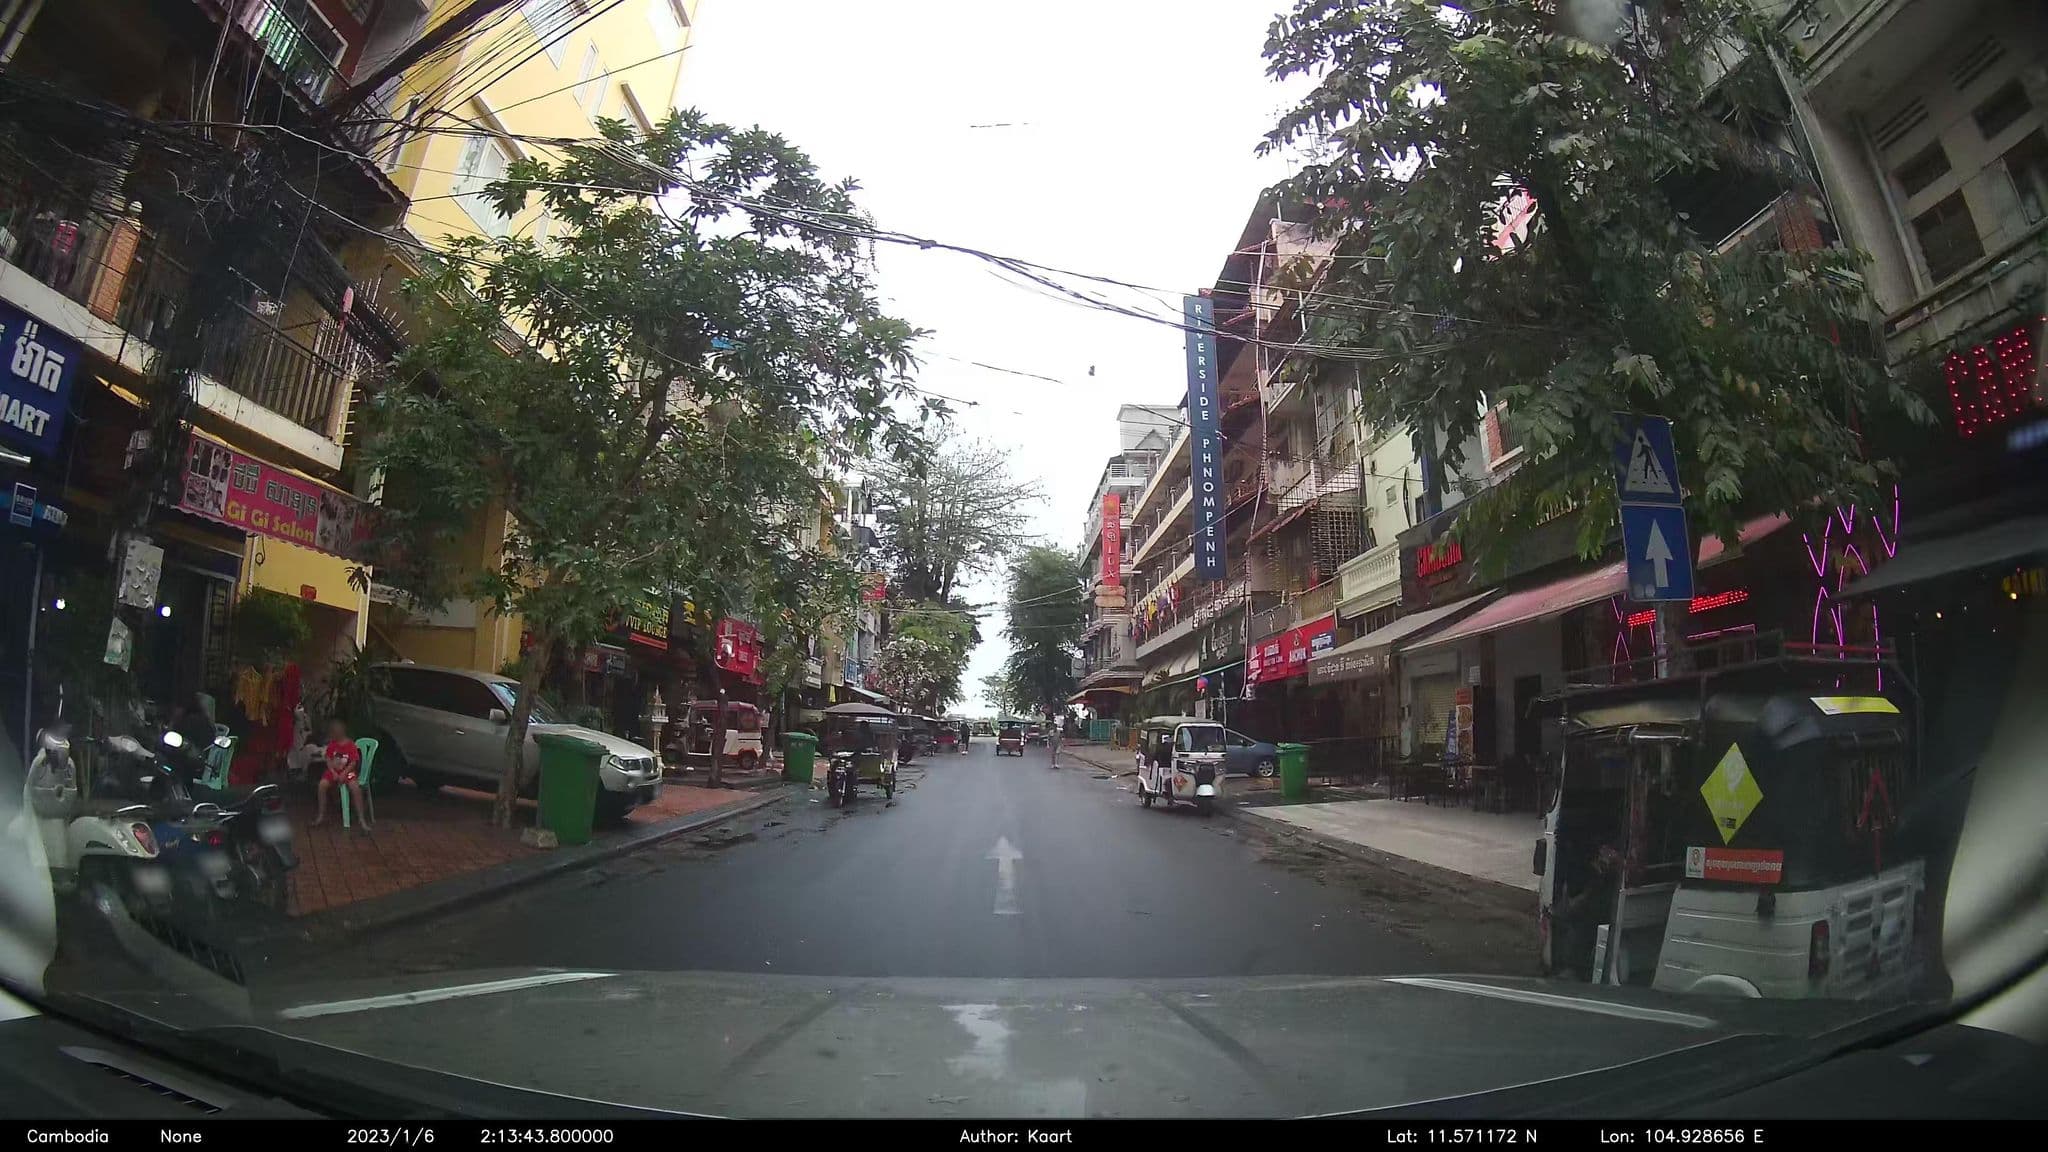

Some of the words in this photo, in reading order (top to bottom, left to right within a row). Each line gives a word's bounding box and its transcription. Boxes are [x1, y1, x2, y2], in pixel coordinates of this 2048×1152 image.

[1194, 304, 1210, 421] RIVERSIDE
[227, 500, 247, 521] Gi
[251, 508, 270, 529] Gi
[272, 515, 315, 542] Salon
